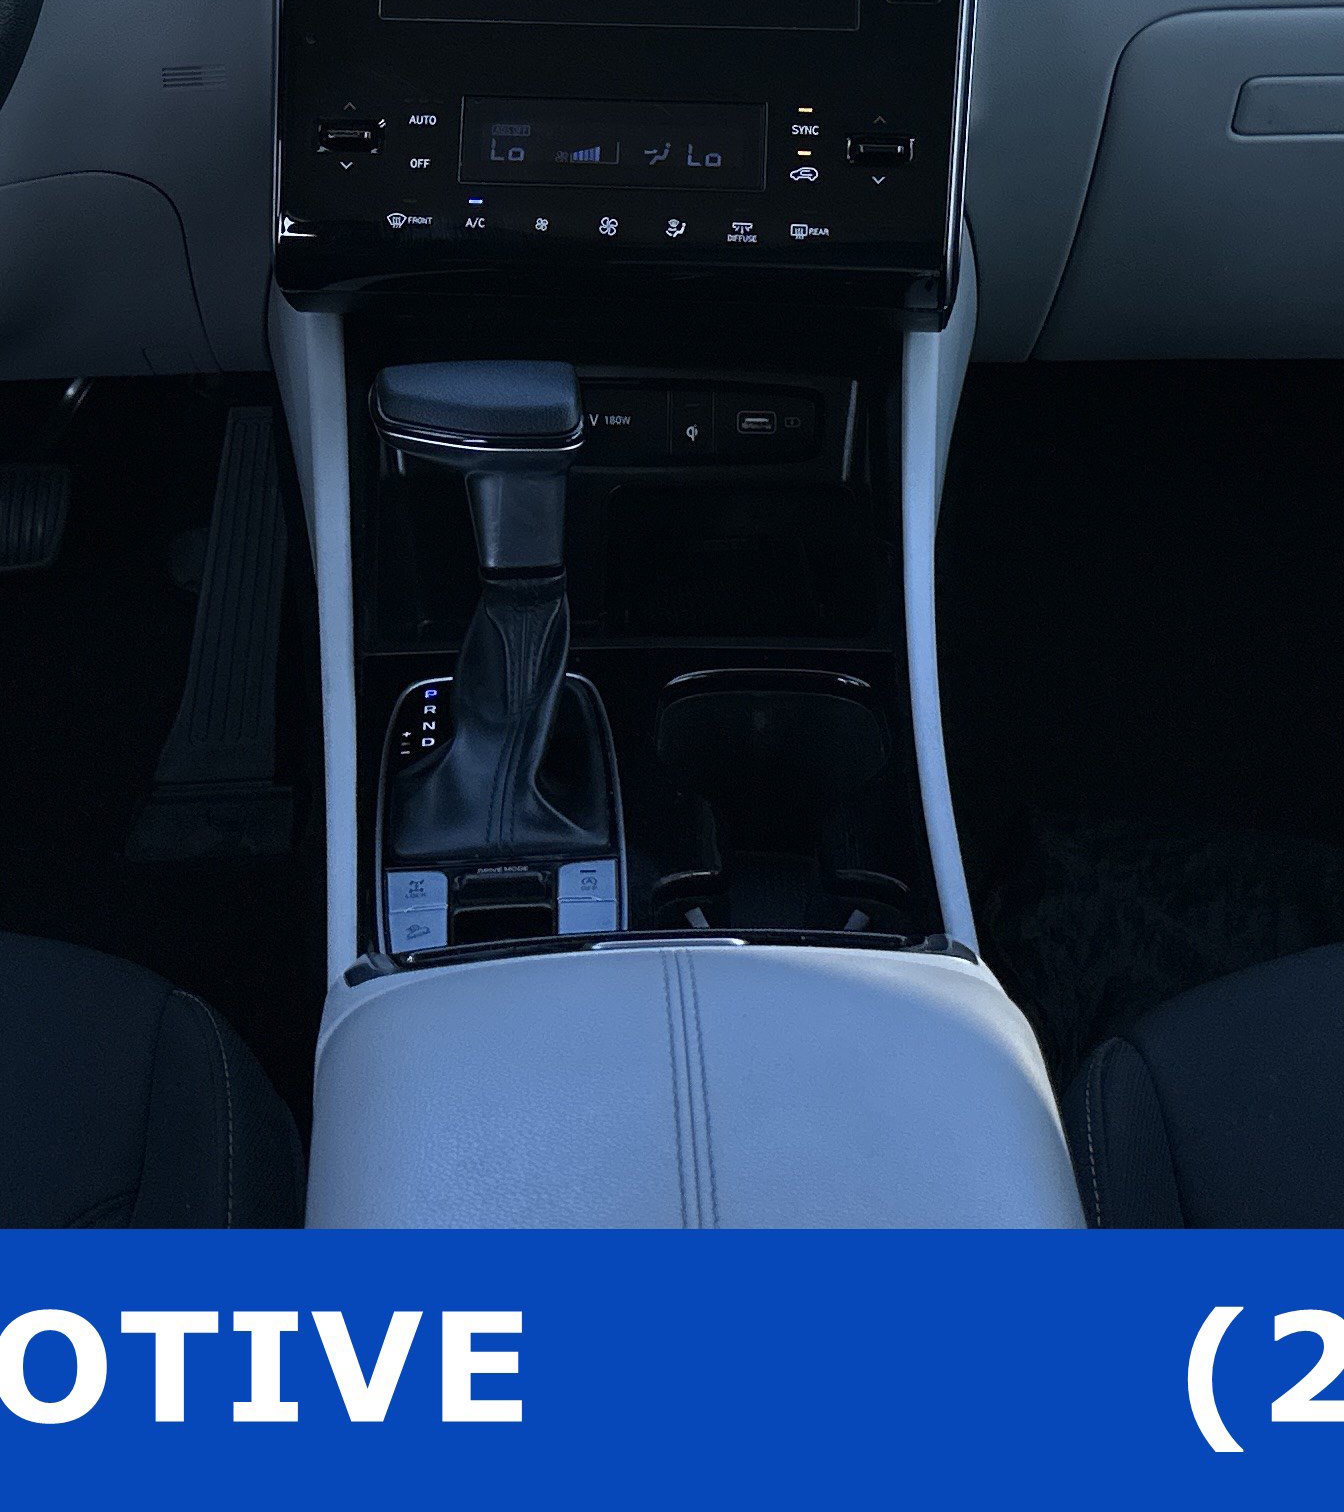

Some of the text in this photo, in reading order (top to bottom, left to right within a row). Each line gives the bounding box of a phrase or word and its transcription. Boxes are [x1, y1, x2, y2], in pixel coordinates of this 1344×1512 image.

[408, 114, 437, 126] AUTO
[791, 125, 819, 136] SYNC
[410, 158, 431, 169] OFF
[407, 215, 433, 225] FRONT
[465, 217, 486, 229] A/C
[808, 227, 830, 236] REAR
[726, 233, 758, 243] DIFFUSE
[604, 415, 632, 426] 180W
[421, 689, 438, 747] P R N D
